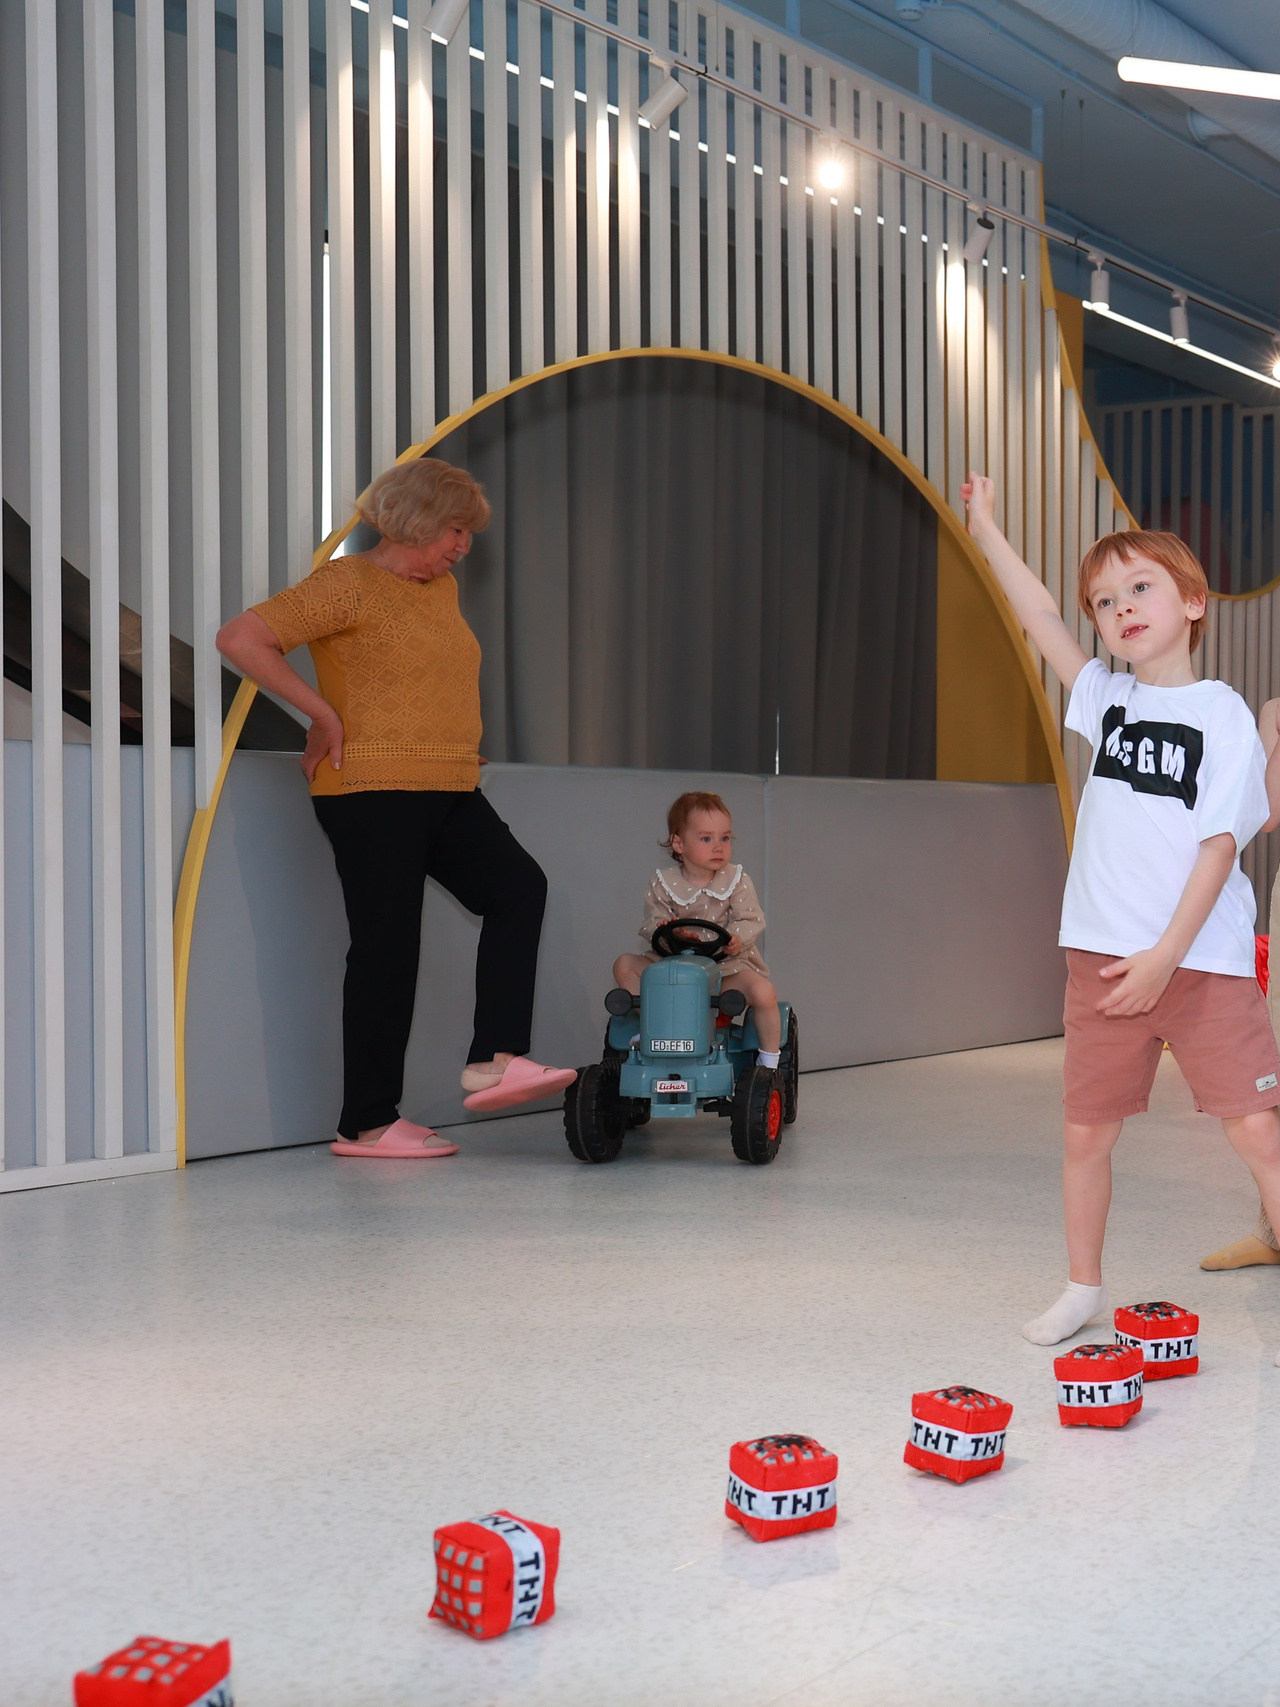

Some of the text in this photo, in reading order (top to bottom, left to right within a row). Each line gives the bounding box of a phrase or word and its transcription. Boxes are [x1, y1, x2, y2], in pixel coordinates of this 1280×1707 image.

[1151, 1338, 1193, 1360] TNT
[1062, 1378, 1144, 1404] TNT TN
[914, 1421, 1007, 1457] TNT TNT
[771, 1486, 830, 1516] TNT
[516, 1550, 541, 1621] TNT
